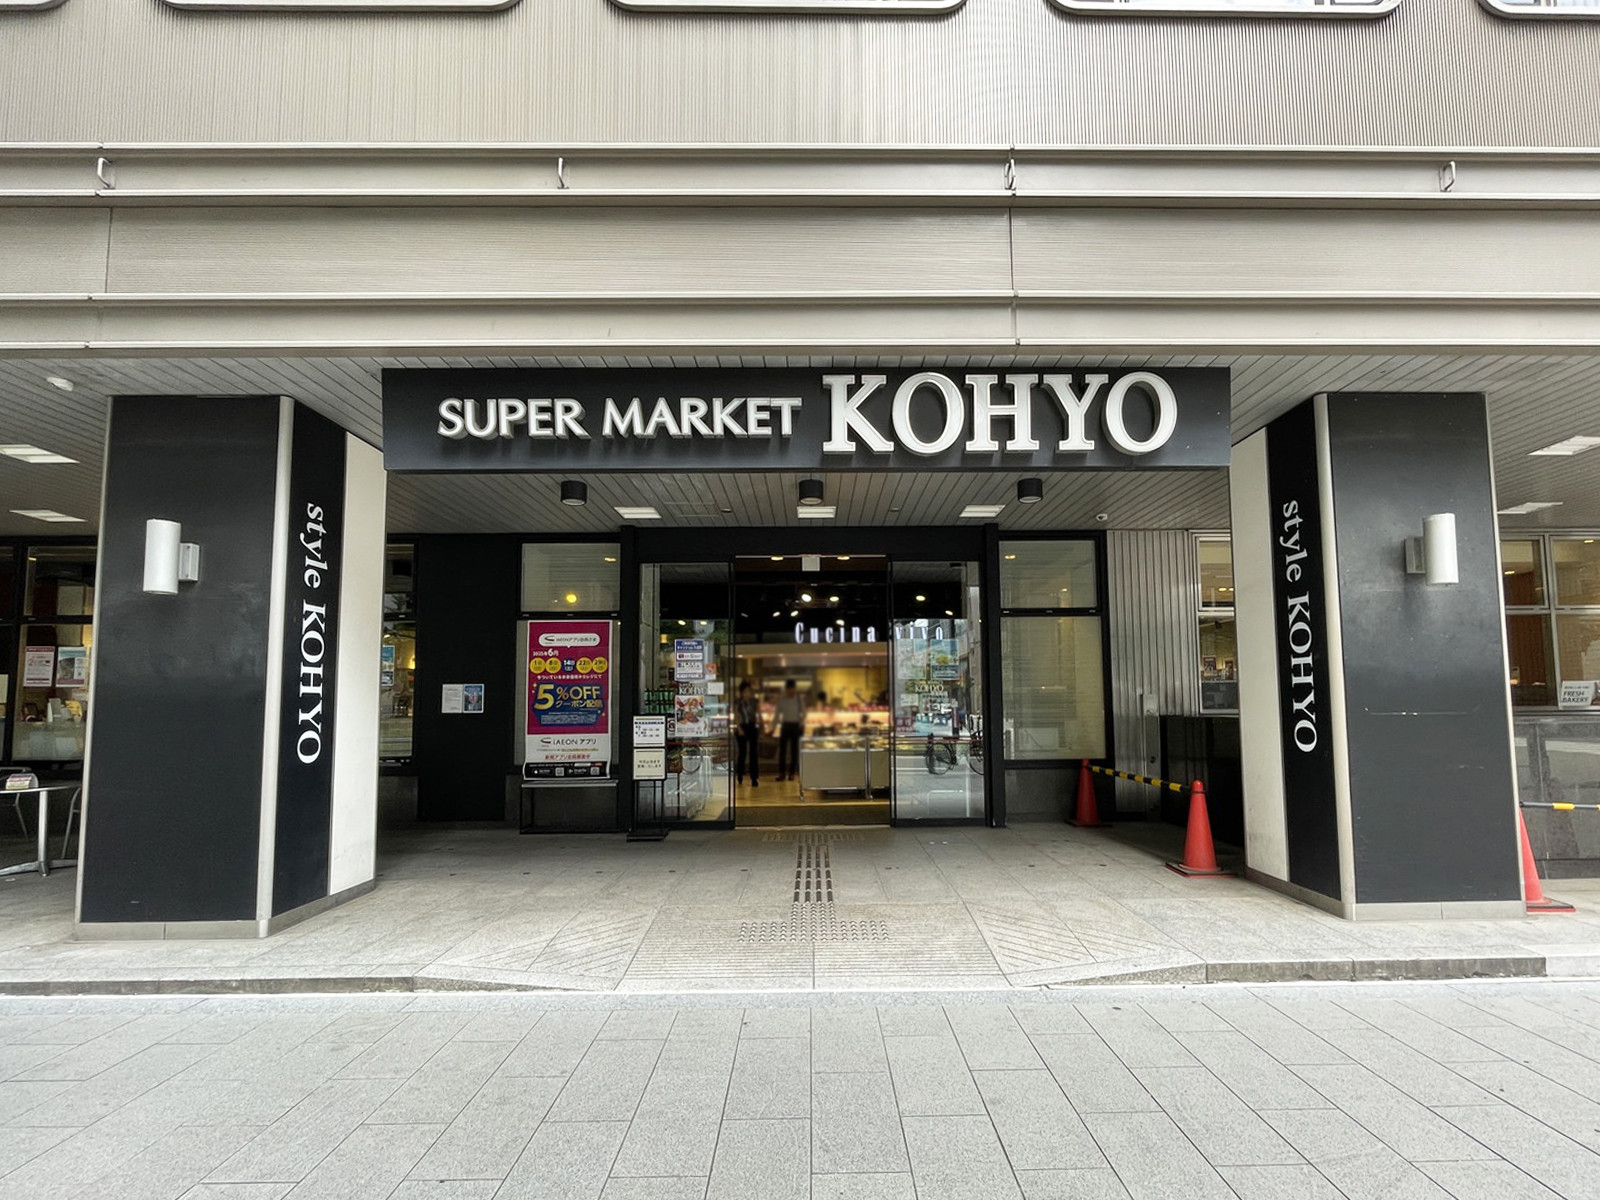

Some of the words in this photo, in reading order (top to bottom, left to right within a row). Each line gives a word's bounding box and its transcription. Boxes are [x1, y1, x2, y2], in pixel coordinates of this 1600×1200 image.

[437, 397, 592, 440] SUPER
[602, 397, 803, 439] MARKET
[822, 371, 1179, 456] KOHYO
[300, 503, 328, 589] style
[1280, 500, 1308, 583] style
[795, 622, 876, 644] Cucina
[895, 622, 944, 640] vivo
[1287, 591, 1318, 753] KOHYO
[297, 599, 326, 764] KOHYO
